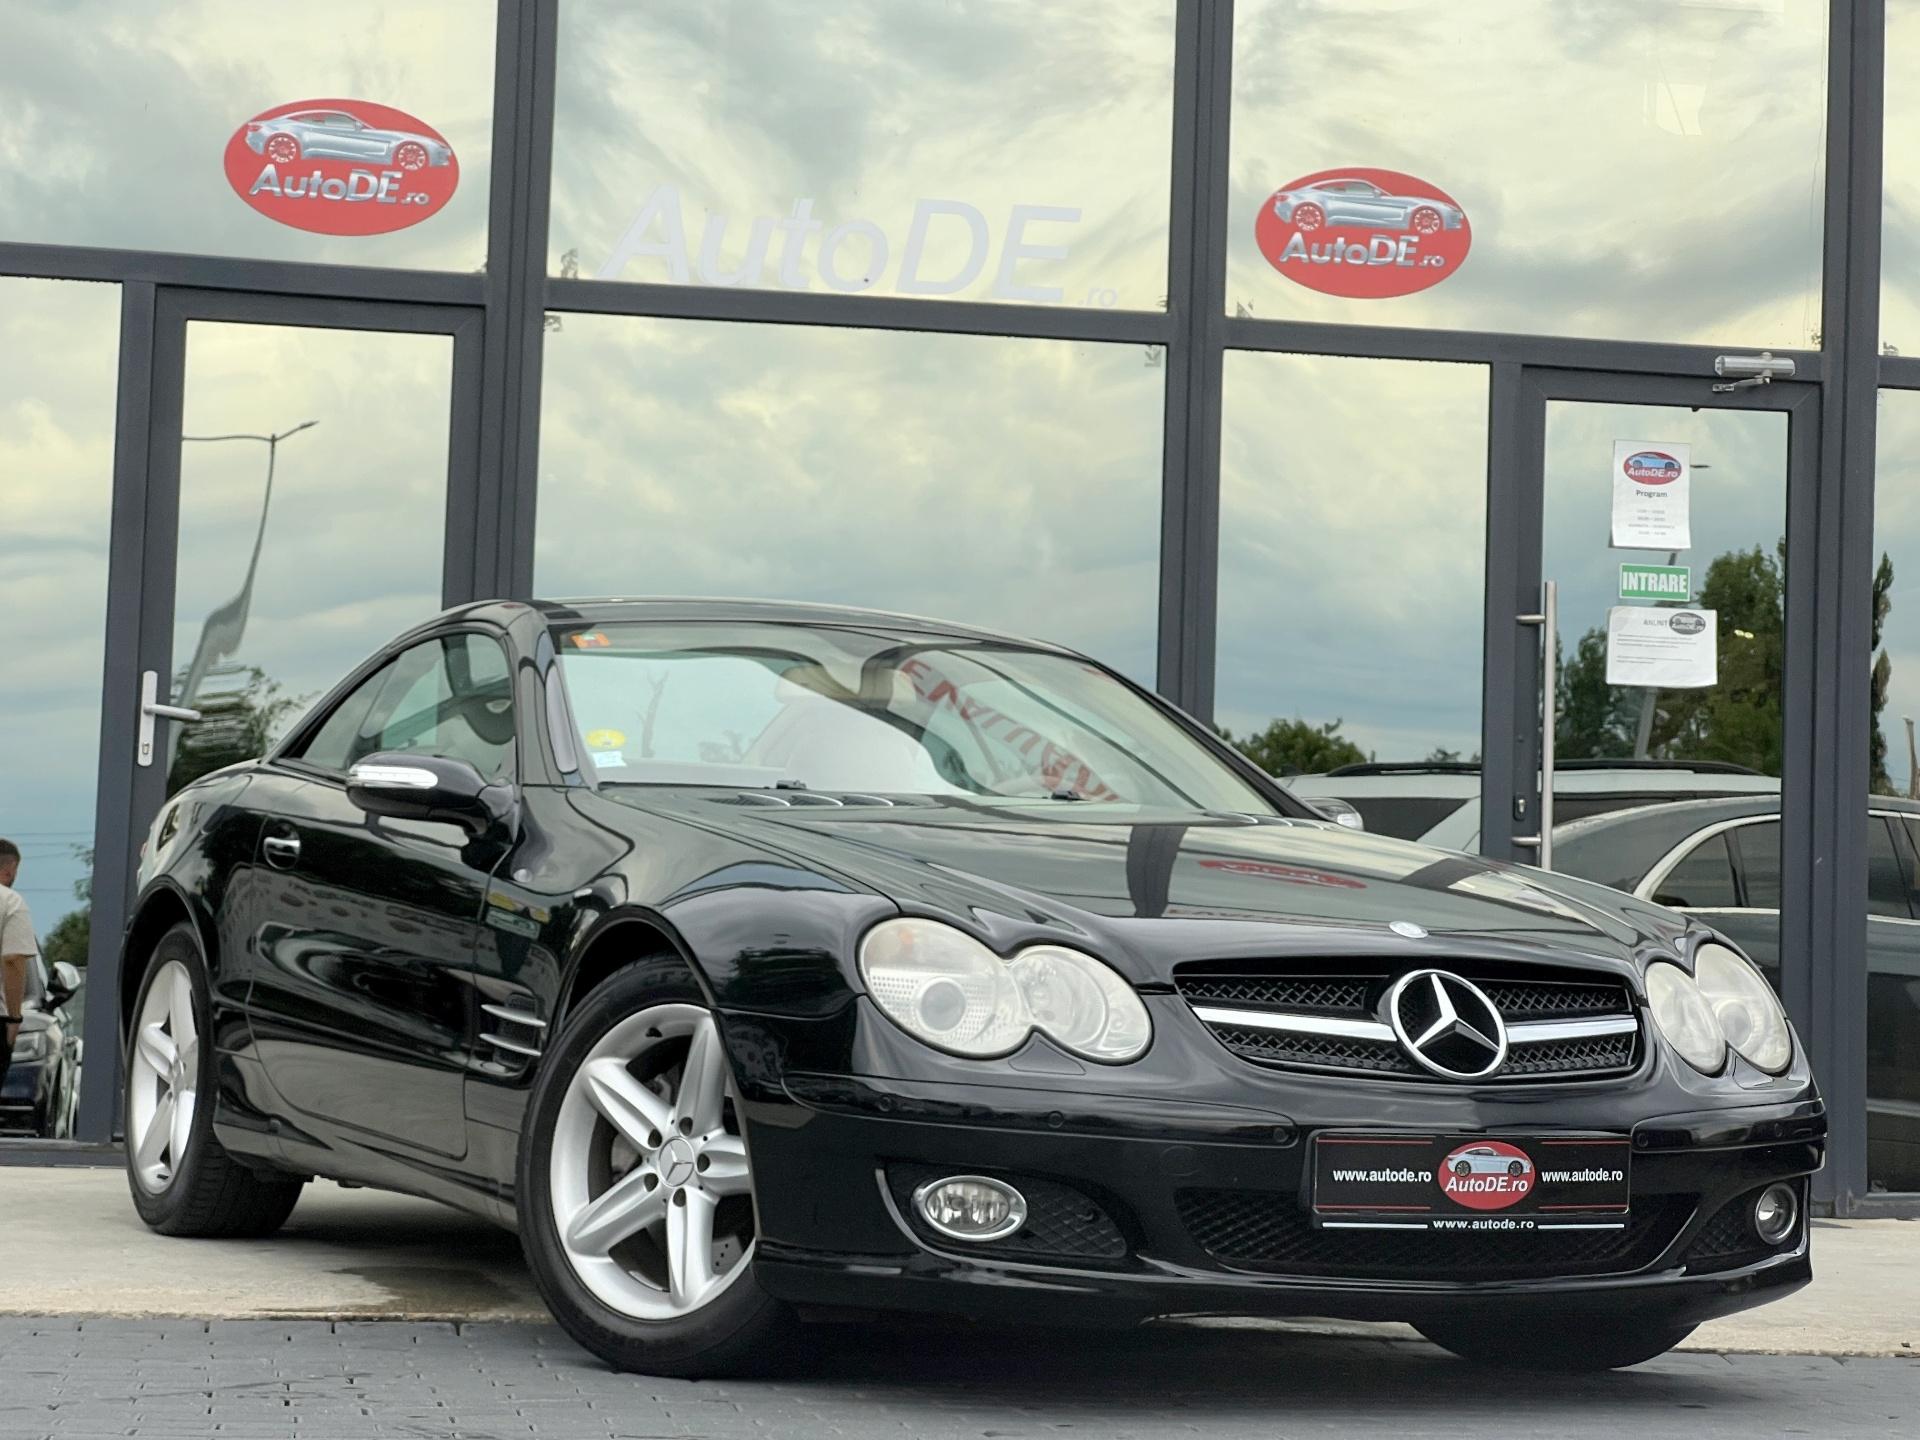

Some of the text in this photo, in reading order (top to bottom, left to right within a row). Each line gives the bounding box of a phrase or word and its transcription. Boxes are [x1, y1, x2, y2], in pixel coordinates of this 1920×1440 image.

[249, 163, 429, 205] AutoDE.ro
[597, 184, 1082, 304] AutoDE
[1280, 232, 1445, 267] AutoDE.ro
[1636, 489, 1668, 498] Program
[1622, 571, 1687, 593] INTRARE
[1333, 1168, 1432, 1183] www.autode.ro
[1542, 1167, 1623, 1182] www.autode.ro
[1445, 1176, 1529, 1193] AutoDE.ro
[1433, 1218, 1535, 1230] www.autode.ro
